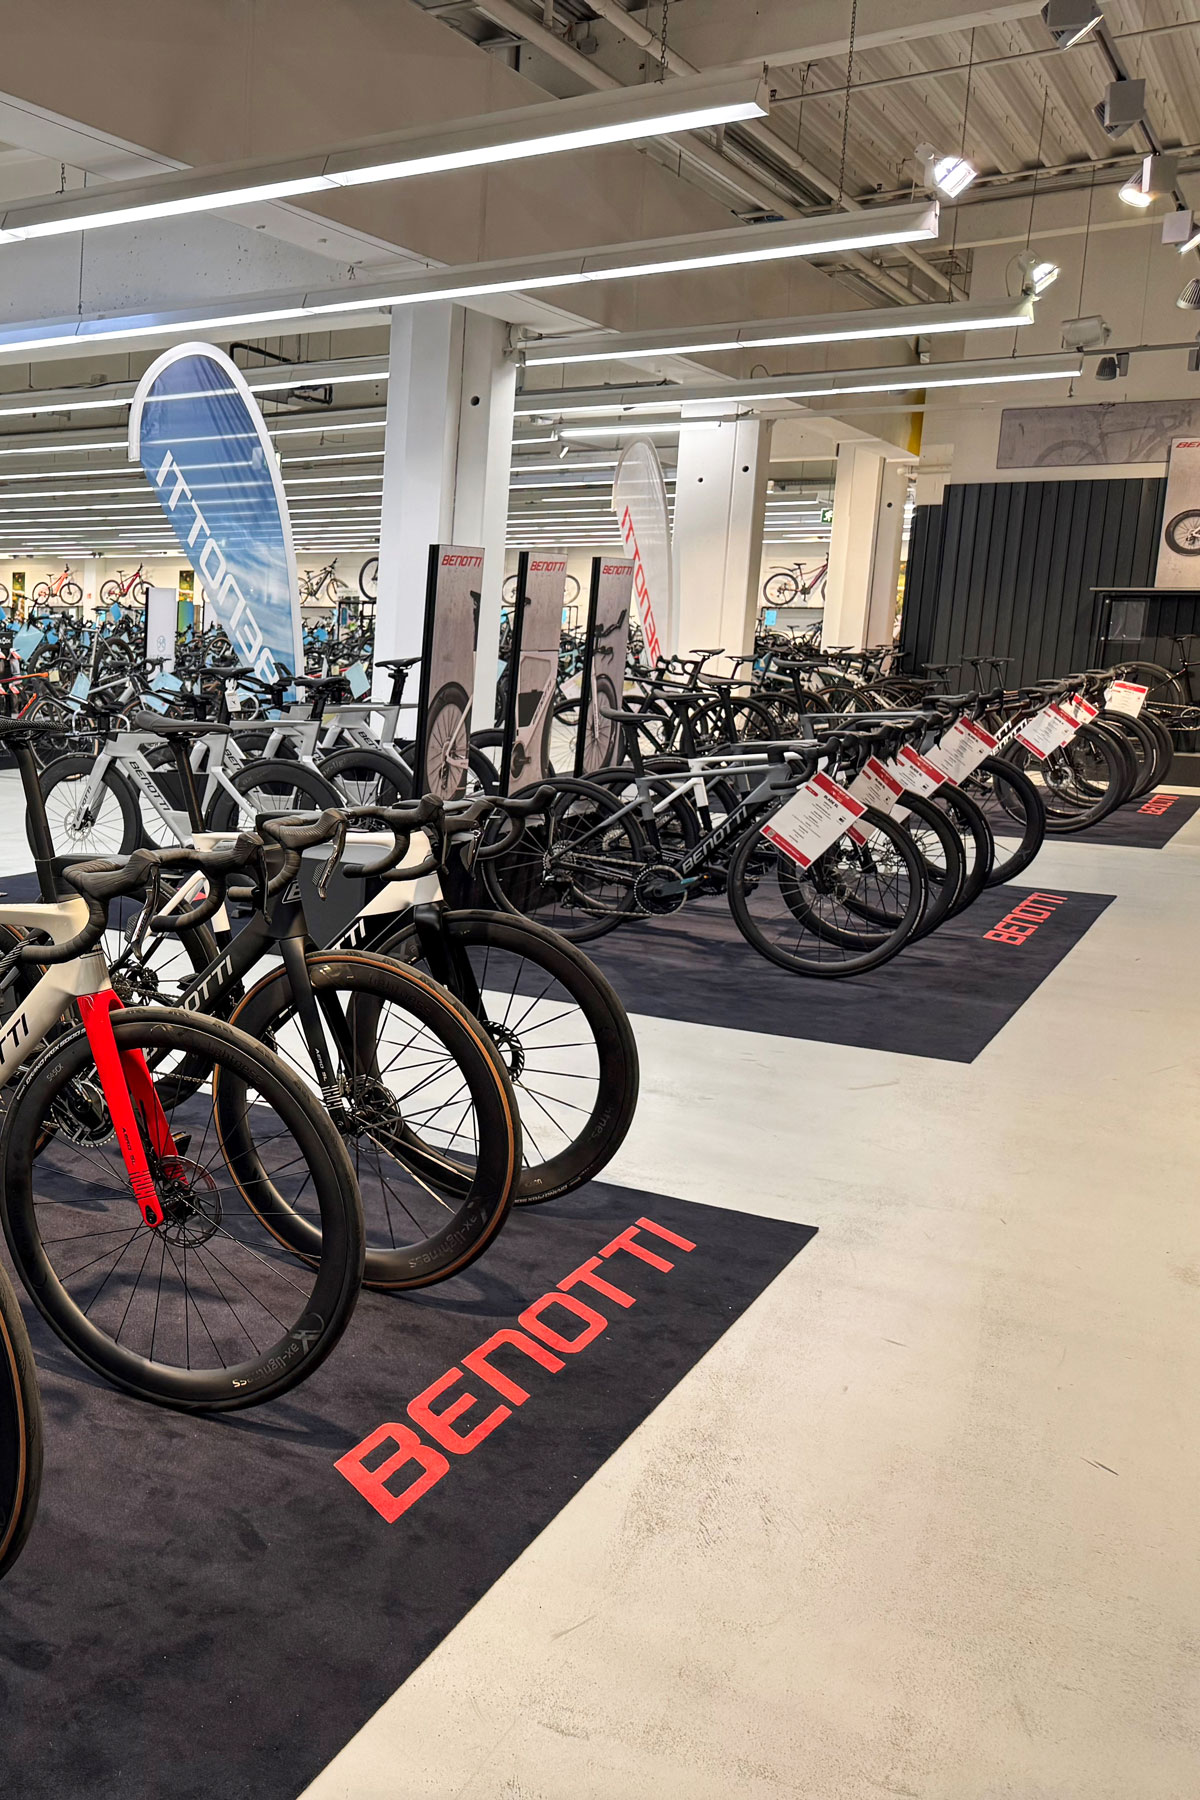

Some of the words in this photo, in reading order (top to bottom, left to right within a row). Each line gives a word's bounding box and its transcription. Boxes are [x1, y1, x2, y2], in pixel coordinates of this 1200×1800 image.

[155, 450, 280, 685] BENOTTI
[441, 554, 482, 567] BENOTTI
[530, 560, 565, 571] BENOTTI
[602, 564, 633, 575] BENOTTI
[129, 761, 171, 811] BENOTTI
[682, 806, 748, 874] BENOTTI
[982, 891, 1068, 946] BENOTTI
[180, 954, 233, 1012] OTTI
[333, 1216, 697, 1524] BENOTTI
